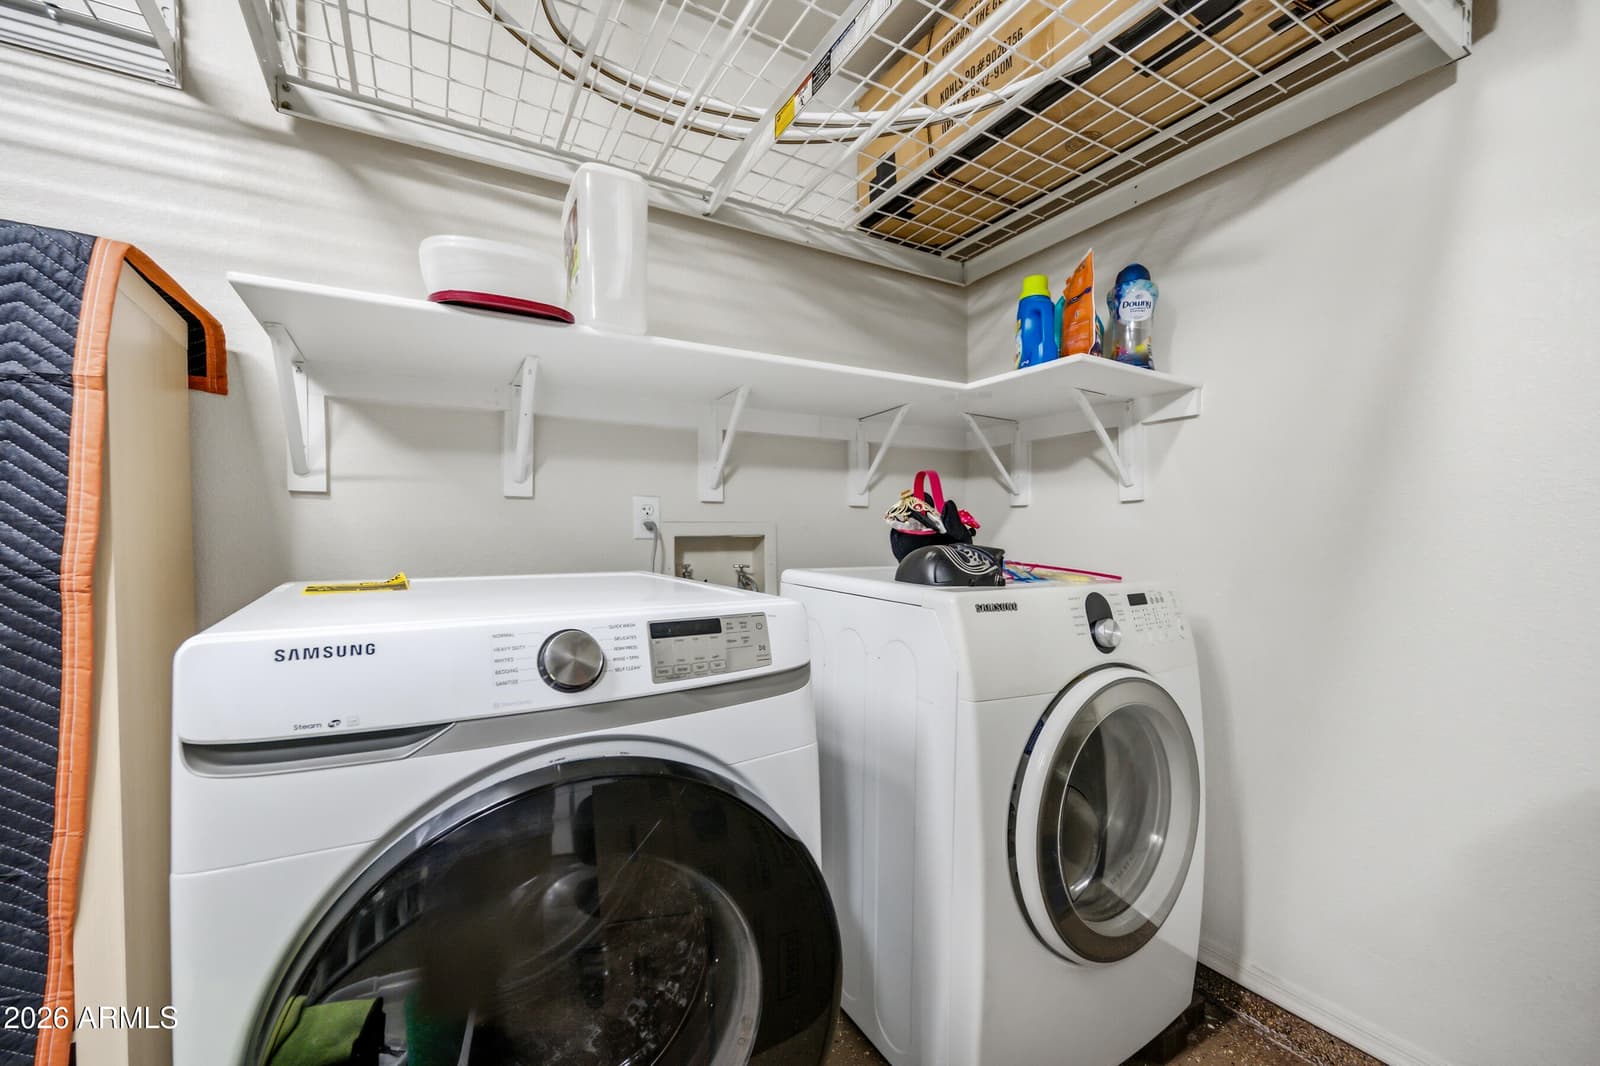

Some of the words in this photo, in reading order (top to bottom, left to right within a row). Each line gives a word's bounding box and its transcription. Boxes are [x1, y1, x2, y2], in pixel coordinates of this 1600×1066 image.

[976, 3, 991, 25] THE
[1122, 300, 1152, 310] Downy
[274, 643, 376, 662] SAMSUNG
[293, 721, 322, 731] Steam
